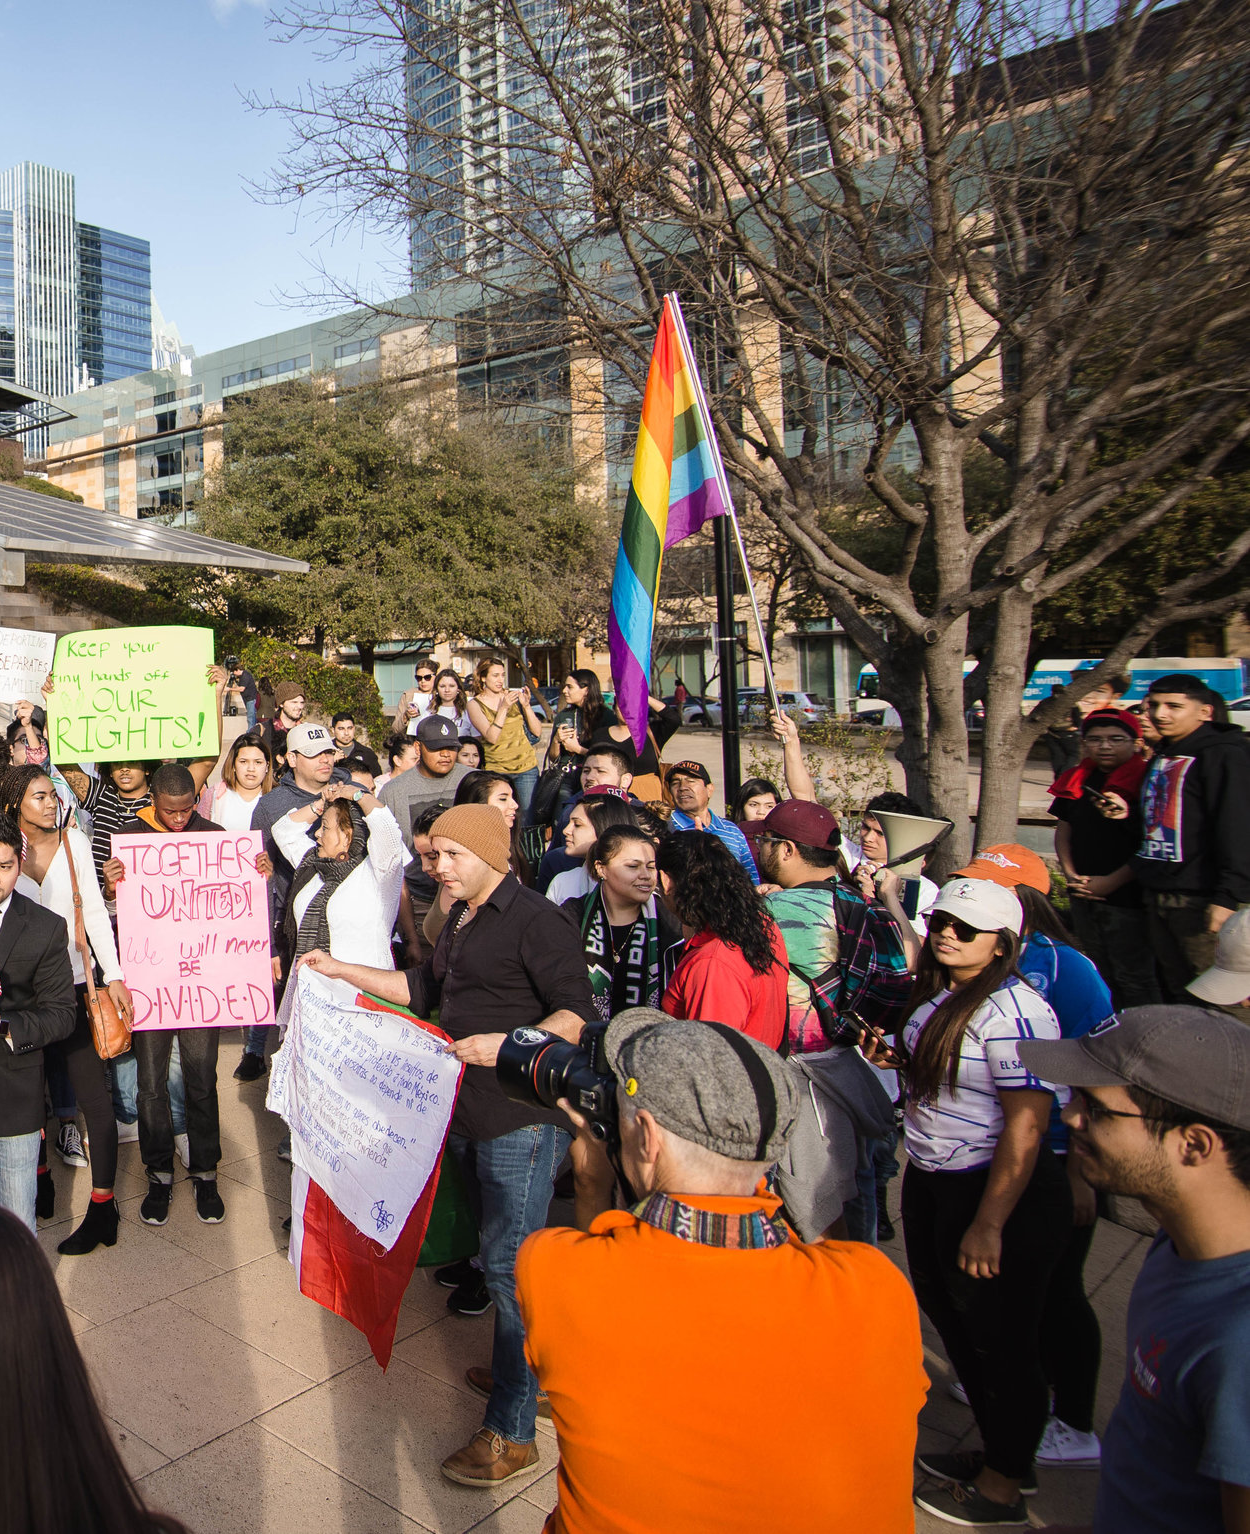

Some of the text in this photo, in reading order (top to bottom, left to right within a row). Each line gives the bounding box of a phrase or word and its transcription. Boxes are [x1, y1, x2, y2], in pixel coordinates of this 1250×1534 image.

[67, 640, 160, 659] Keep your
[91, 668, 132, 682] hands
[144, 670, 170, 682] off
[93, 687, 157, 713] OUR
[57, 711, 205, 756] RIGHTS!
[307, 729, 326, 740] CAT
[119, 837, 257, 879] TOGETHER
[141, 879, 254, 922] UNITED!
[126, 933, 269, 966] We will never
[178, 960, 202, 978] BE
[999, 1060, 1010, 1070] EL
[426, 1070, 438, 1083] de
